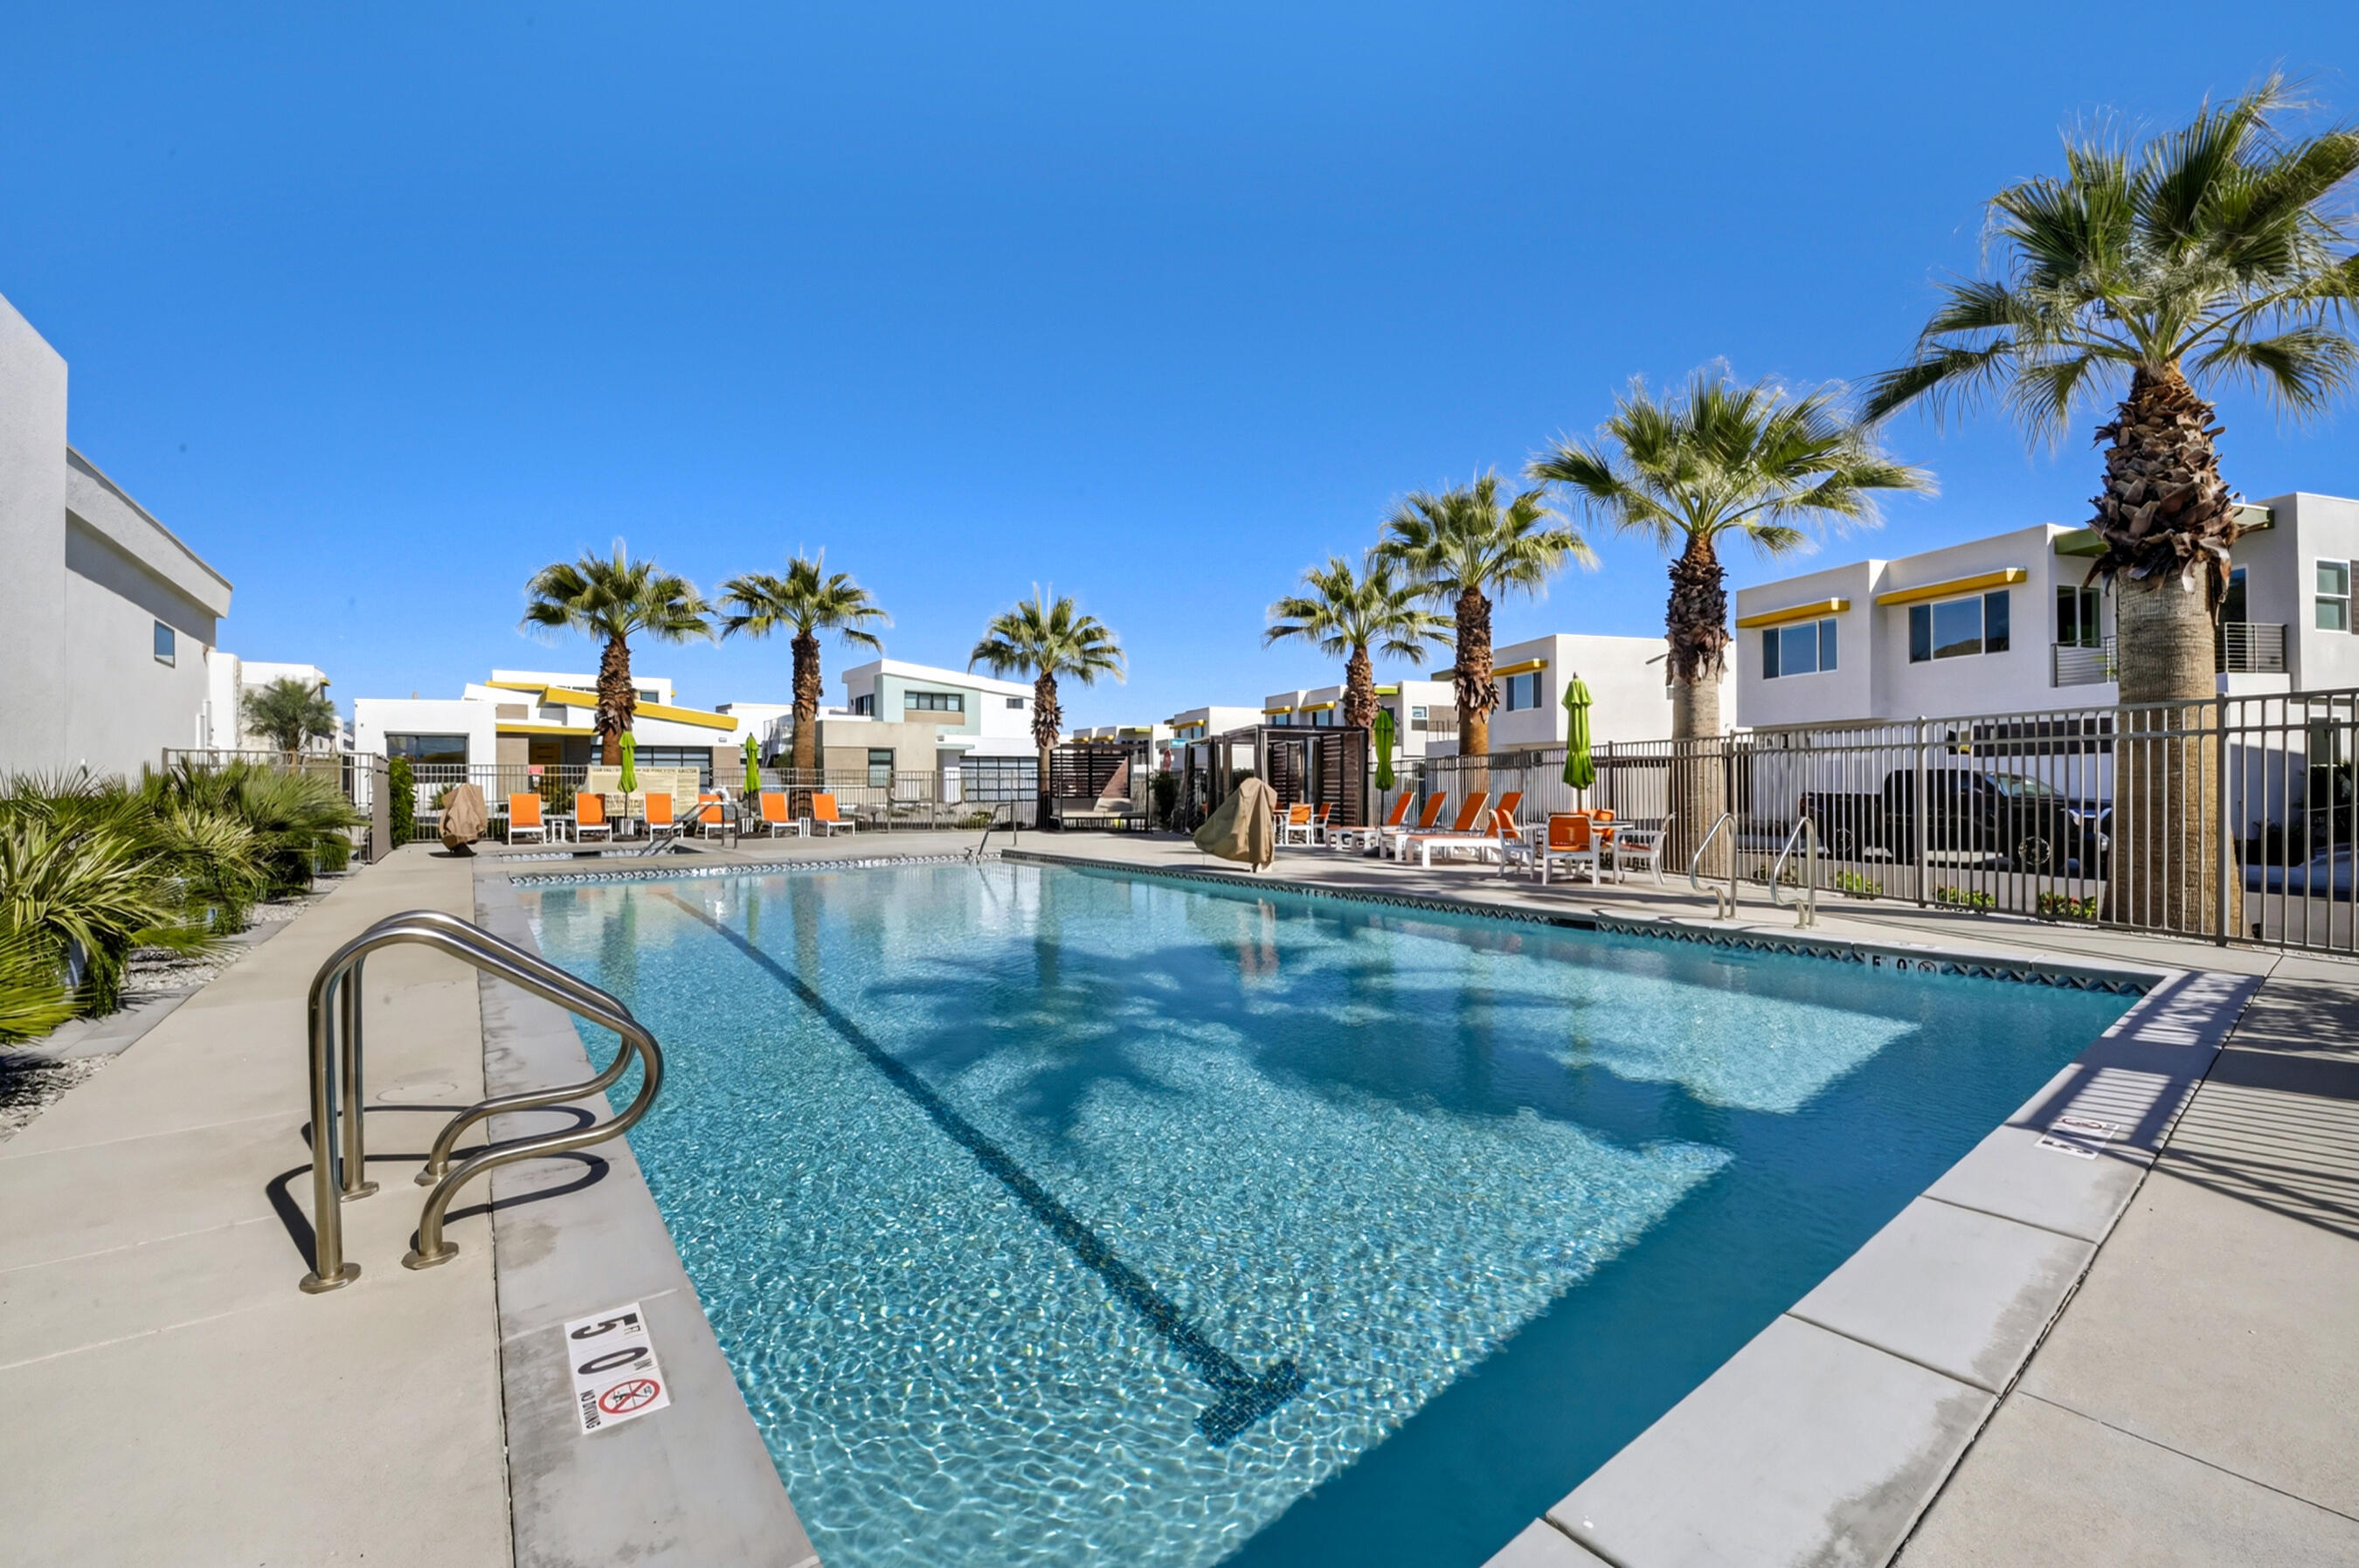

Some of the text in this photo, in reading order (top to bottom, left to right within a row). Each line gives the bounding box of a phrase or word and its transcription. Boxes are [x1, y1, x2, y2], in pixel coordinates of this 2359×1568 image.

[571, 1312, 638, 1340] 5
[578, 1346, 648, 1375] 0
[580, 1389, 601, 1429] NO DIVING
